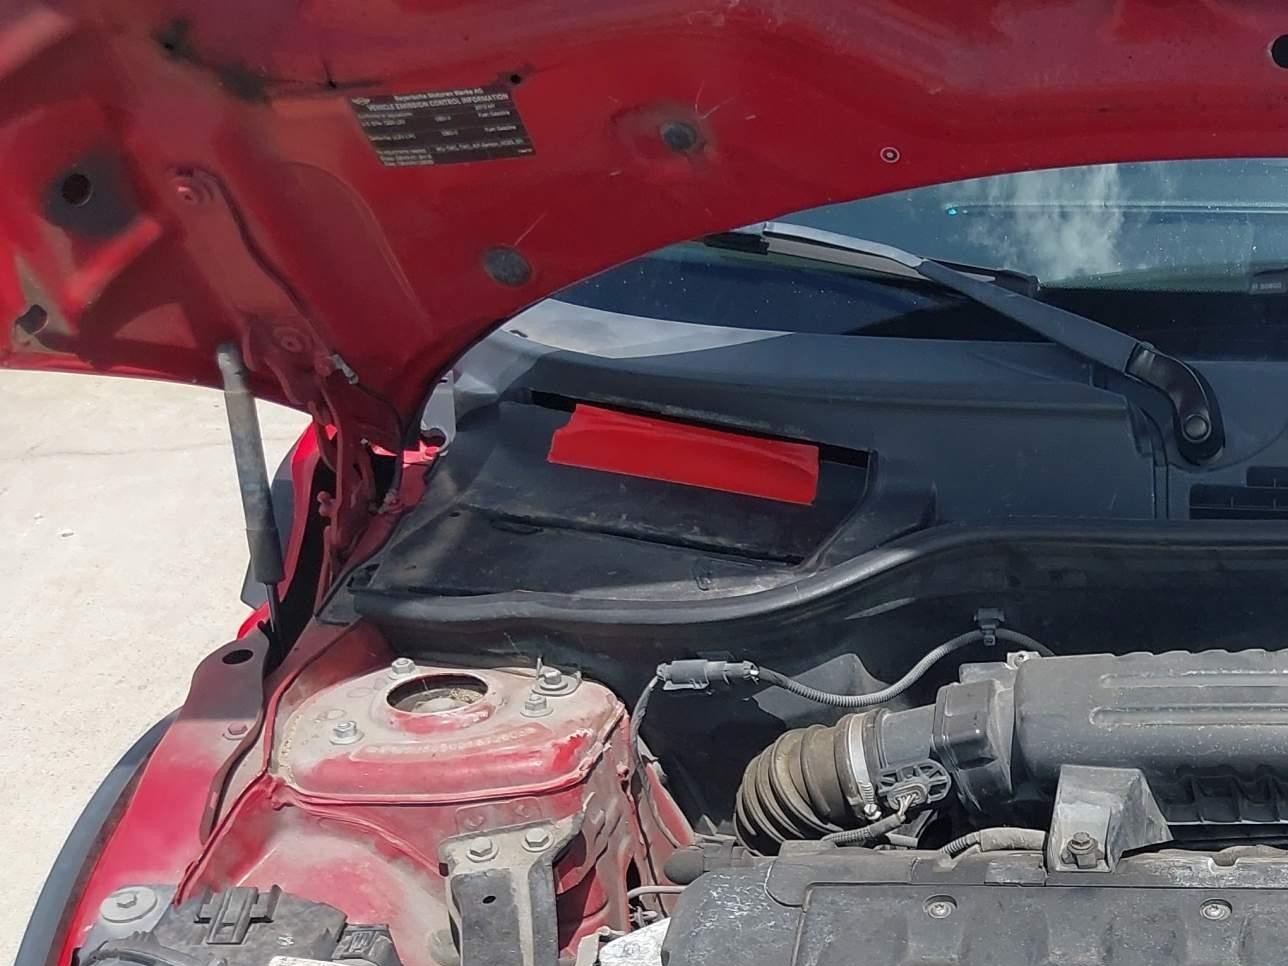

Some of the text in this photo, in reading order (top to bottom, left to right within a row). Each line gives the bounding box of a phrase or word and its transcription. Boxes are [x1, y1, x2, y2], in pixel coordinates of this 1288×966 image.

[367, 93, 509, 112] VEHICLE EMISSION CONTROL INFORMATION
